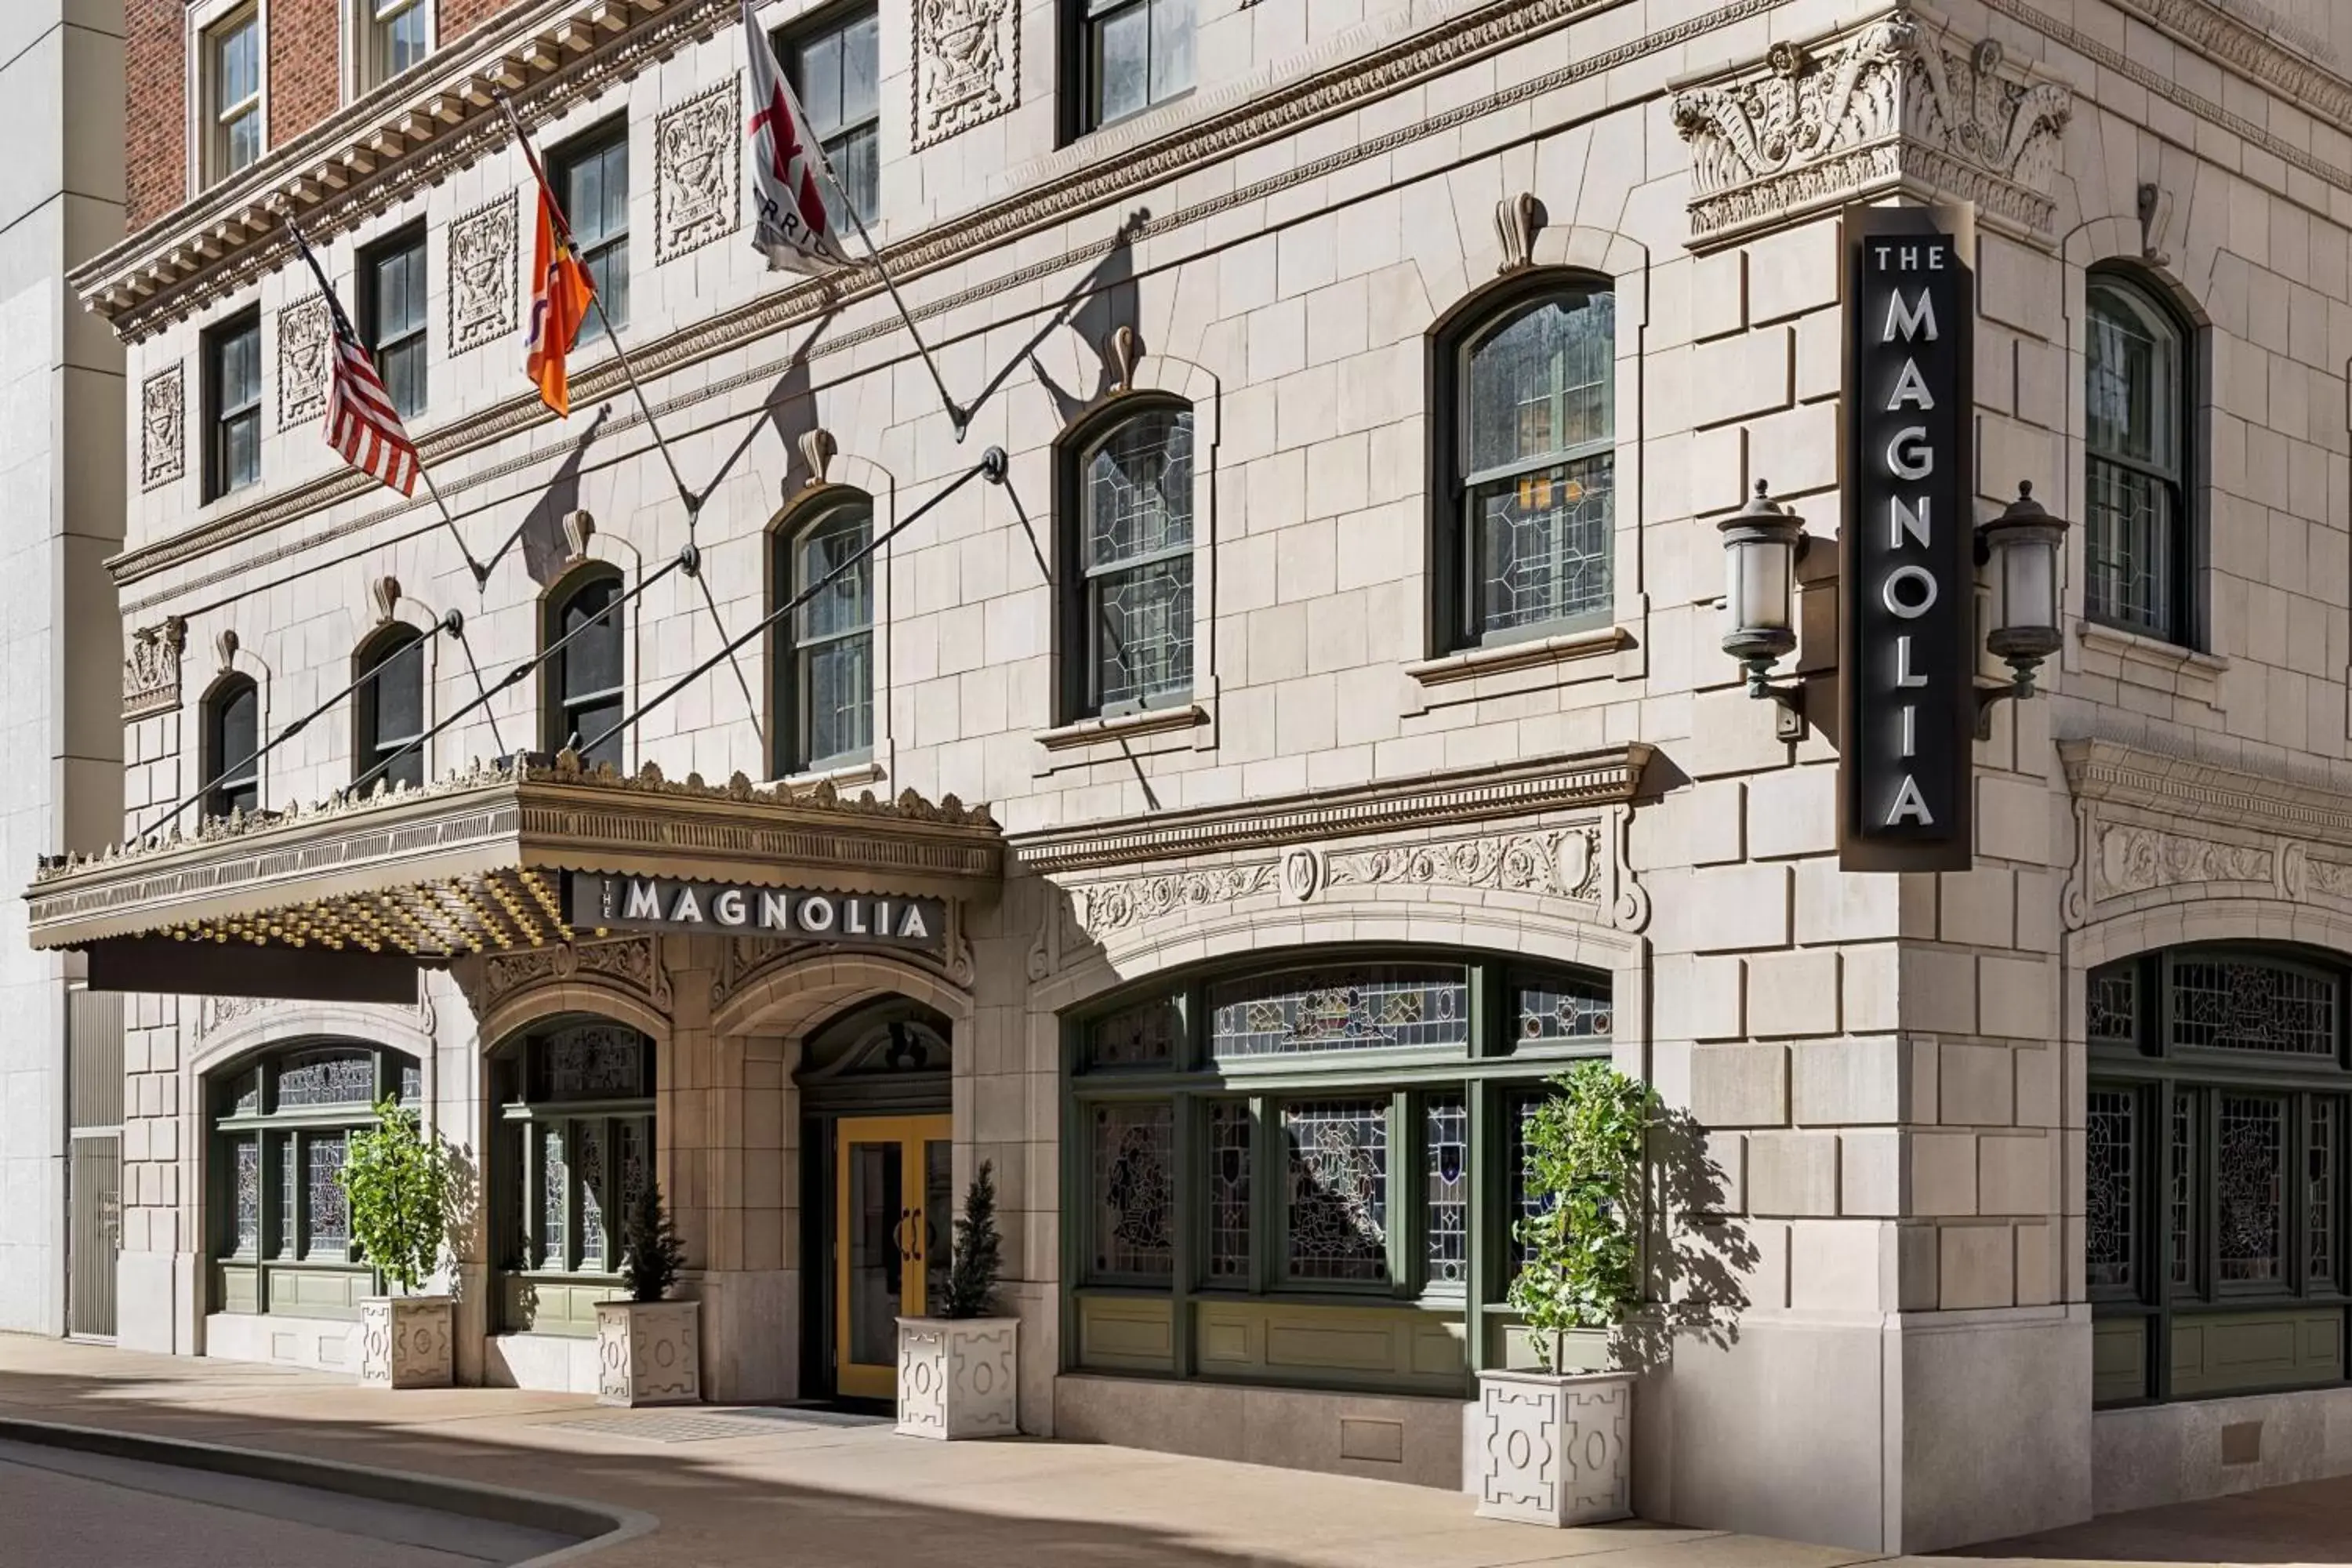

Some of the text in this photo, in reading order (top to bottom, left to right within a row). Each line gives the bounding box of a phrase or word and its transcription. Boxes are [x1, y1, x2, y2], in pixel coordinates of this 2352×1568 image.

[1875, 246, 1945, 270] THE
[1882, 286, 1939, 826] MAGNOLIA
[602, 879, 928, 938] THE MAGNOLIA
